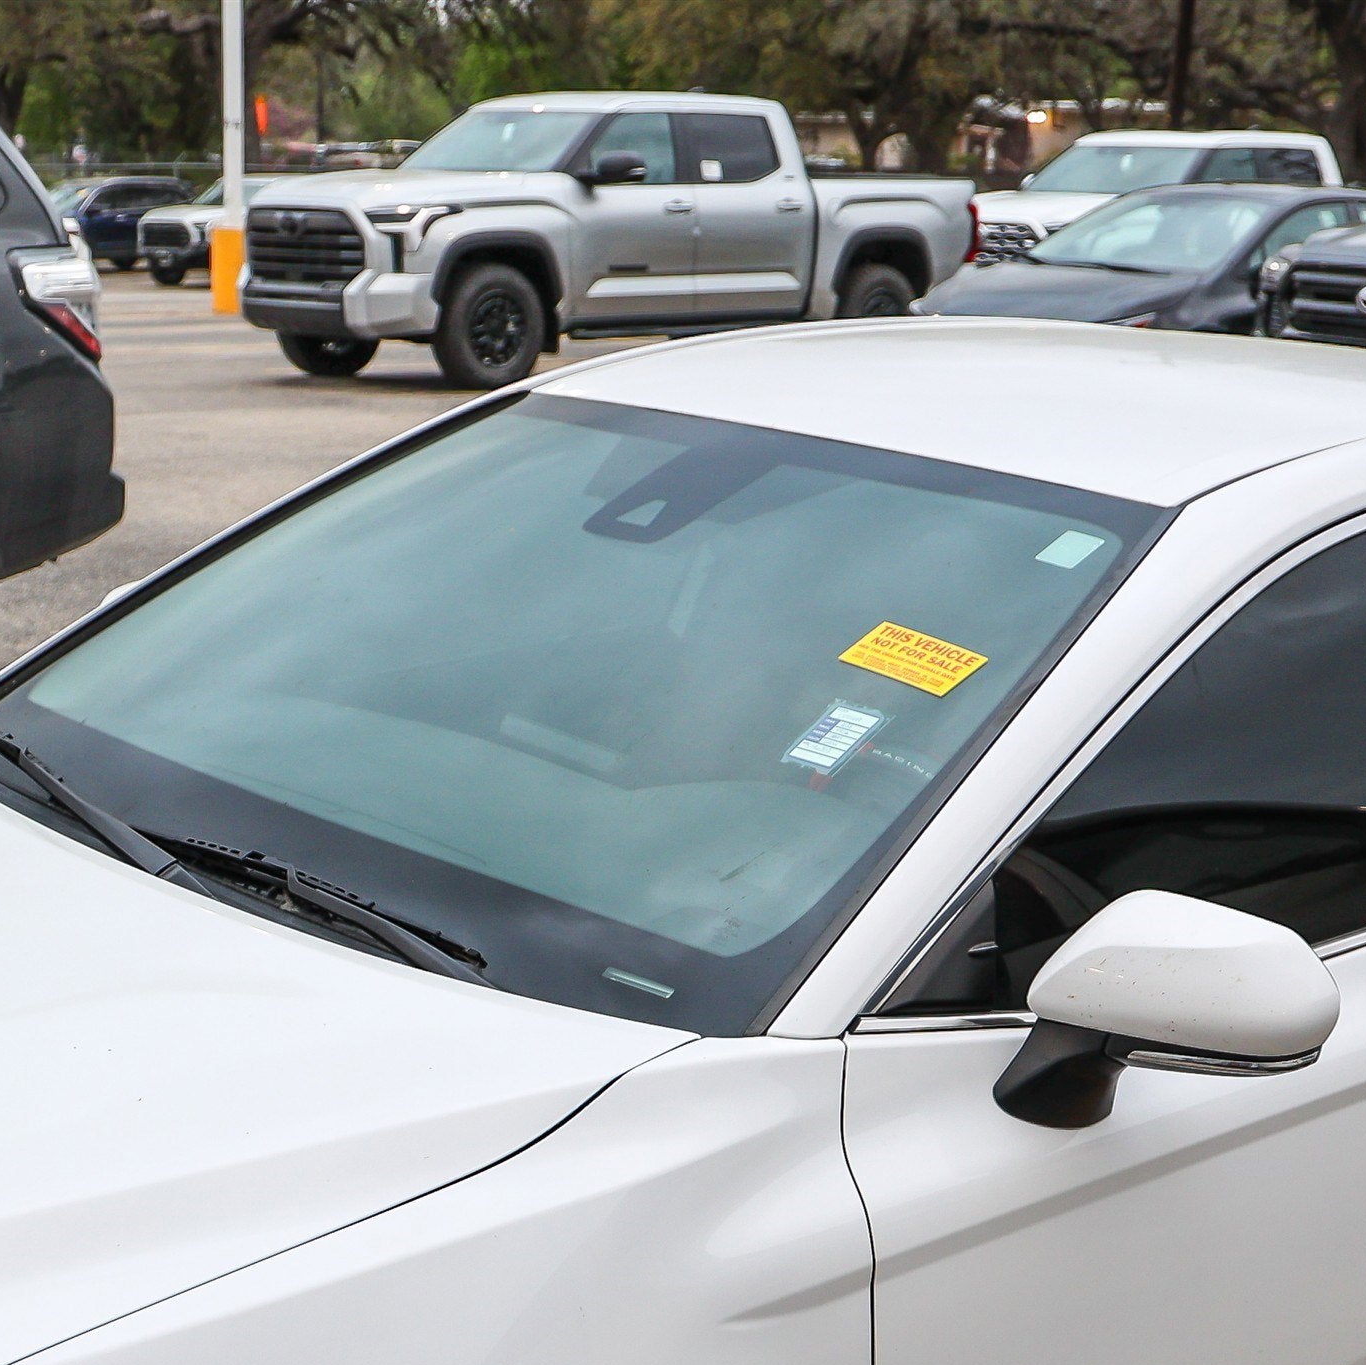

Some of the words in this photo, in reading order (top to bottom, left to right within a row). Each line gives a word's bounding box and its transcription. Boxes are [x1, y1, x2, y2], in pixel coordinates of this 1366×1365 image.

[871, 637, 899, 650] NOT
[898, 646, 927, 660] FOR
[927, 656, 963, 673] SALE
[878, 625, 914, 643] THIS
[914, 637, 980, 667] VEHICLE
